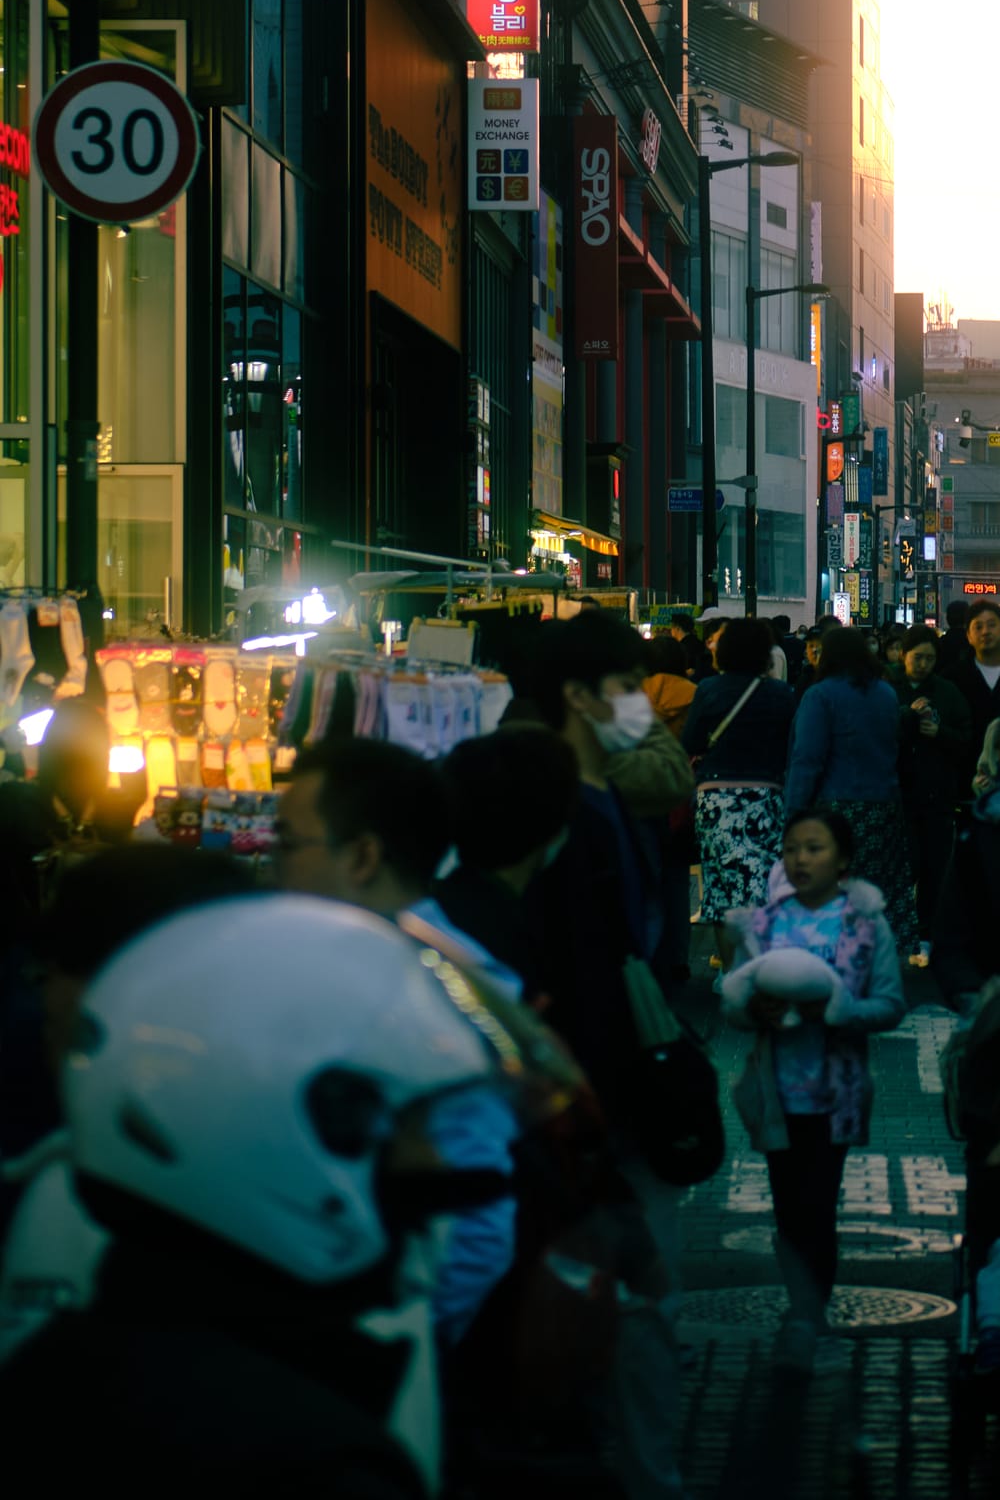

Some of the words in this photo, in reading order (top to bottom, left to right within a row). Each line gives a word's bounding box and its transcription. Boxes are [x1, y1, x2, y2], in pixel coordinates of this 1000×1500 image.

[484, 118, 520, 128] MONEY
[70, 107, 165, 177] 30
[475, 131, 530, 141] EXCHANGE
[581, 147, 610, 246] SPAO
[583, 340, 610, 349] 스파오
[829, 534, 842, 561] 안경
